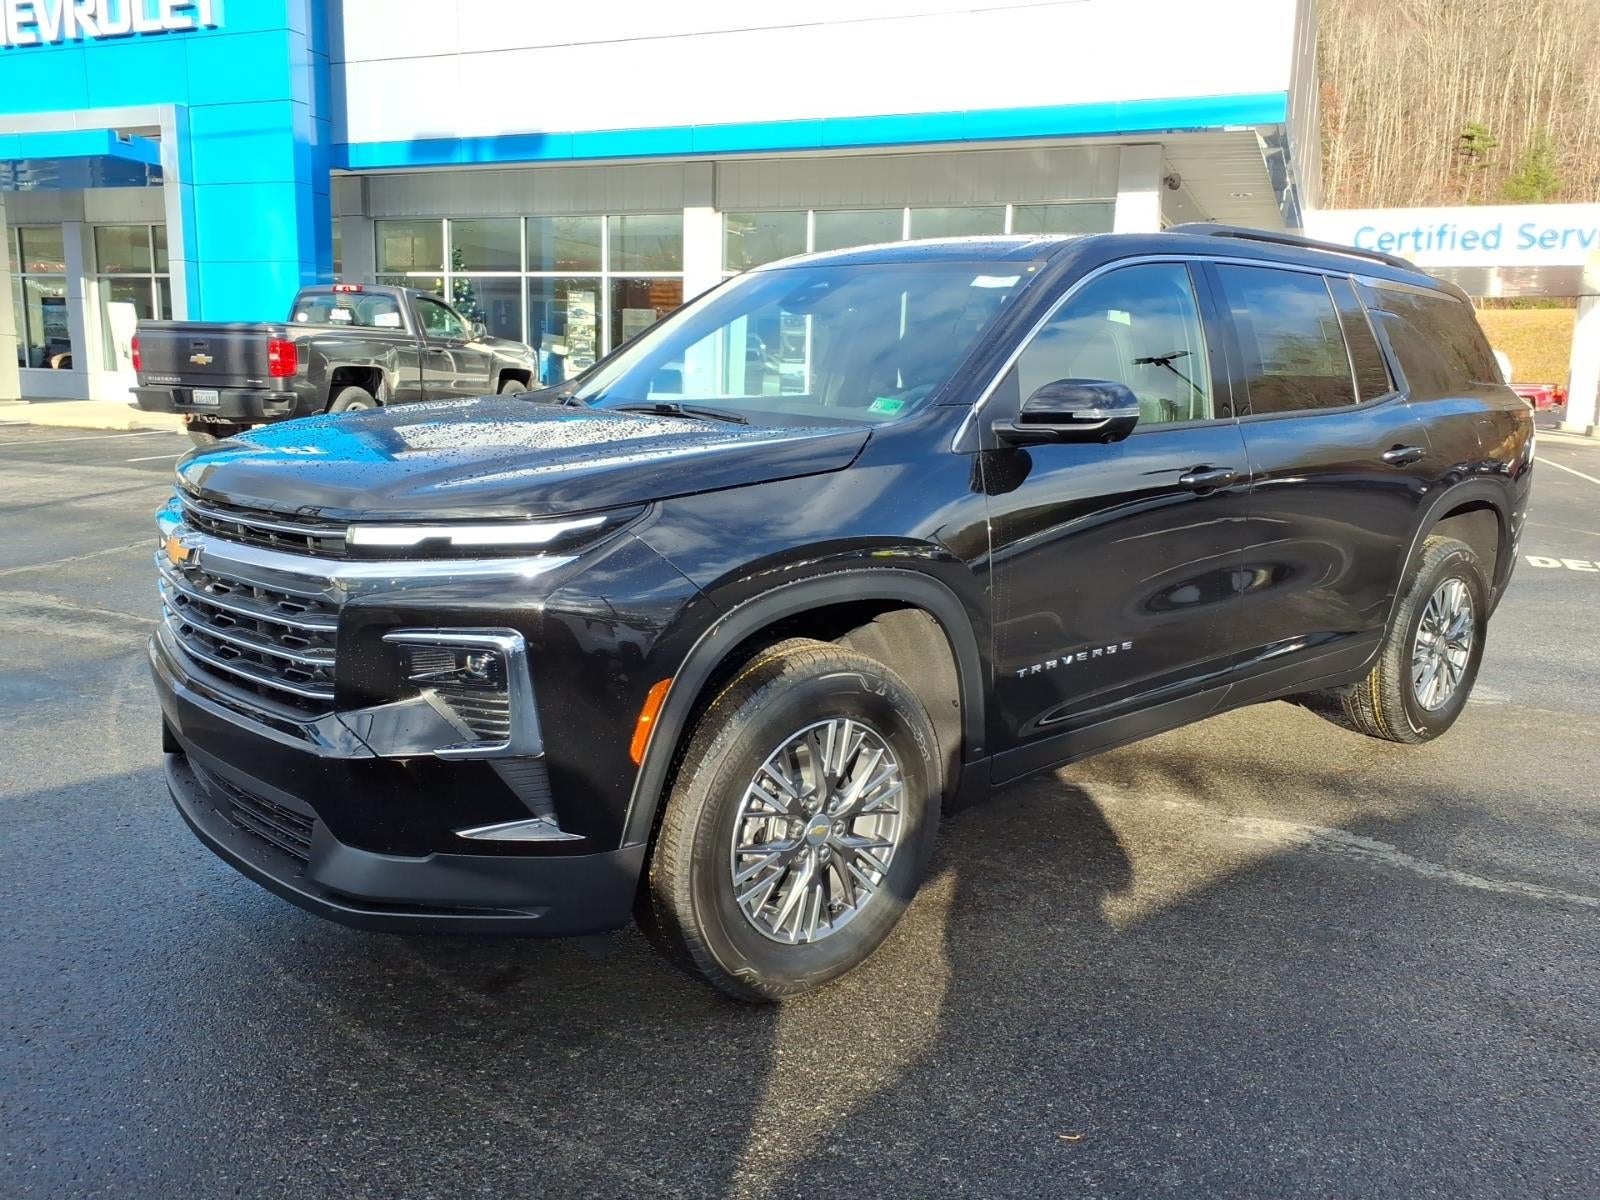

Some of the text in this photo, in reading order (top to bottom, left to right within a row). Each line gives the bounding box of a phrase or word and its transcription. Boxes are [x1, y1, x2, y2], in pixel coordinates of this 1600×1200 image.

[0, 0, 214, 45] EVROLE
[1354, 222, 1600, 252] Certified Serv
[1525, 555, 1600, 572] DE
[1016, 641, 1133, 679] TRAVERSE
